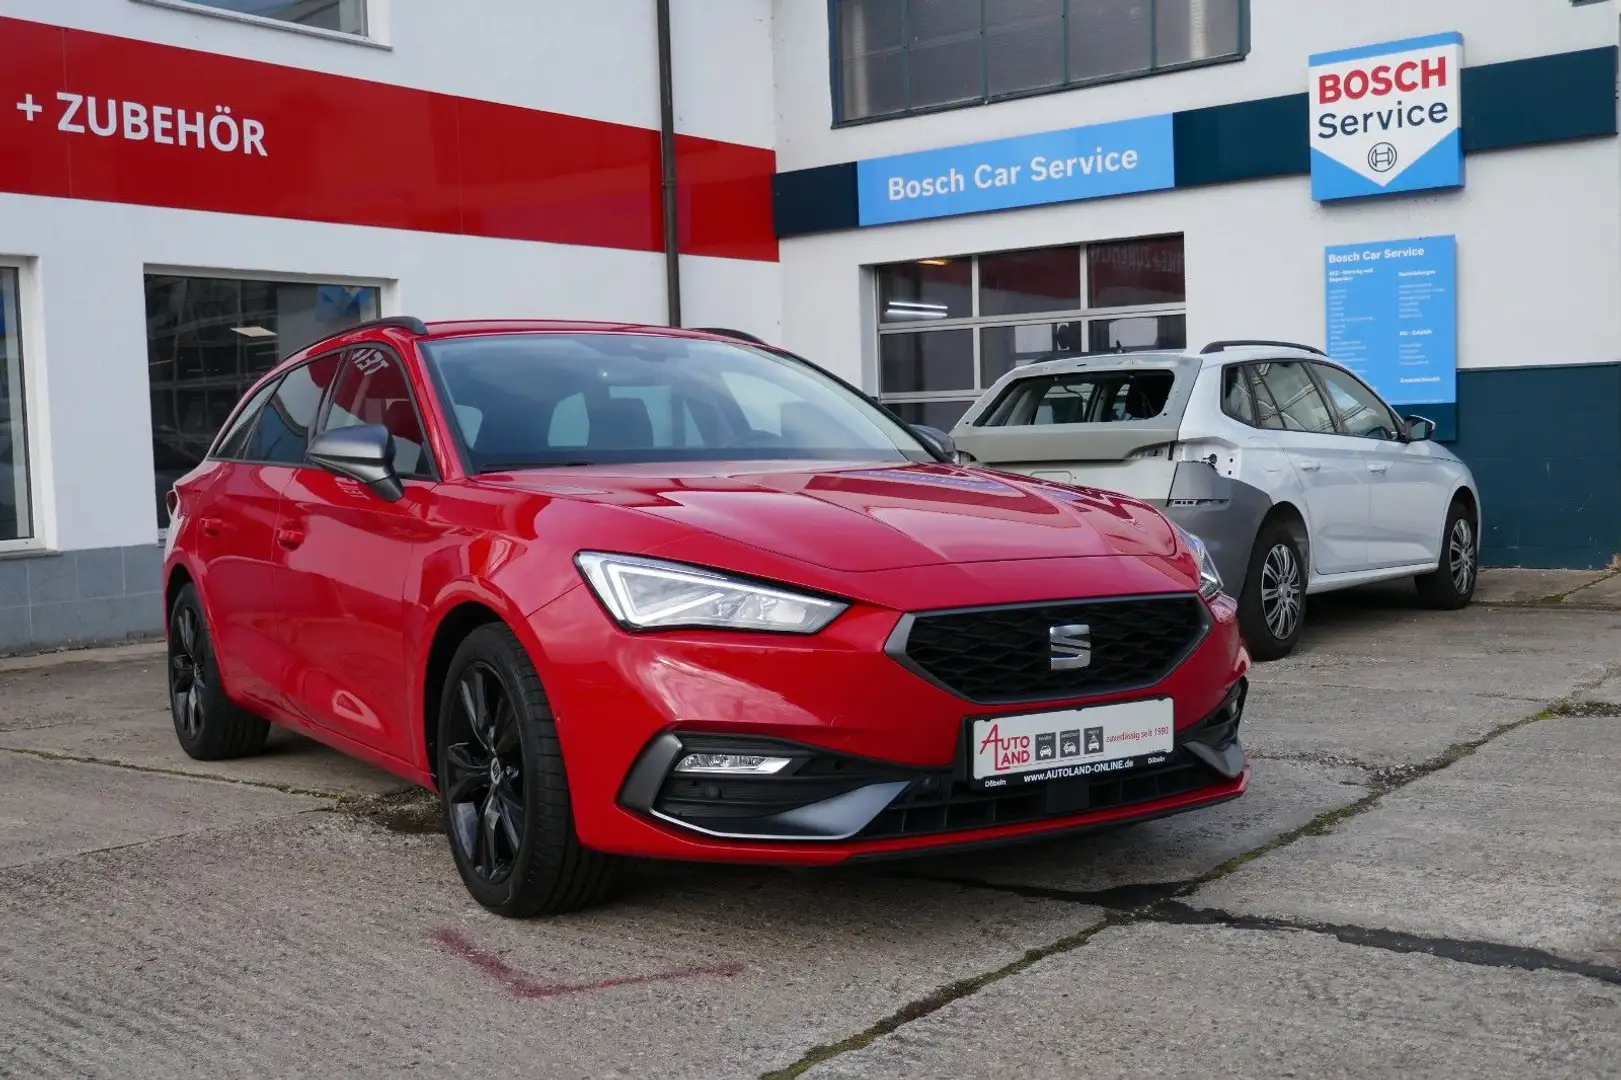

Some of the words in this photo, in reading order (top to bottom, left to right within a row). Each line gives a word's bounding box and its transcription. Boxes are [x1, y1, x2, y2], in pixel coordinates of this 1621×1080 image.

[1318, 56, 1447, 105] BOSCH
[56, 91, 268, 156] ZUBEHÖR
[1318, 100, 1448, 139] Service
[888, 168, 965, 201] Bosch
[974, 164, 1021, 189] Car
[1030, 146, 1139, 182] Service
[1328, 252, 1360, 264] Bosch
[1362, 250, 1381, 261] Car
[1384, 246, 1425, 259] Service
[980, 724, 1030, 755] AUTO
[994, 750, 1030, 771] LAND
[1023, 759, 1134, 783] www.AUTOLAND-ONLINE.de
